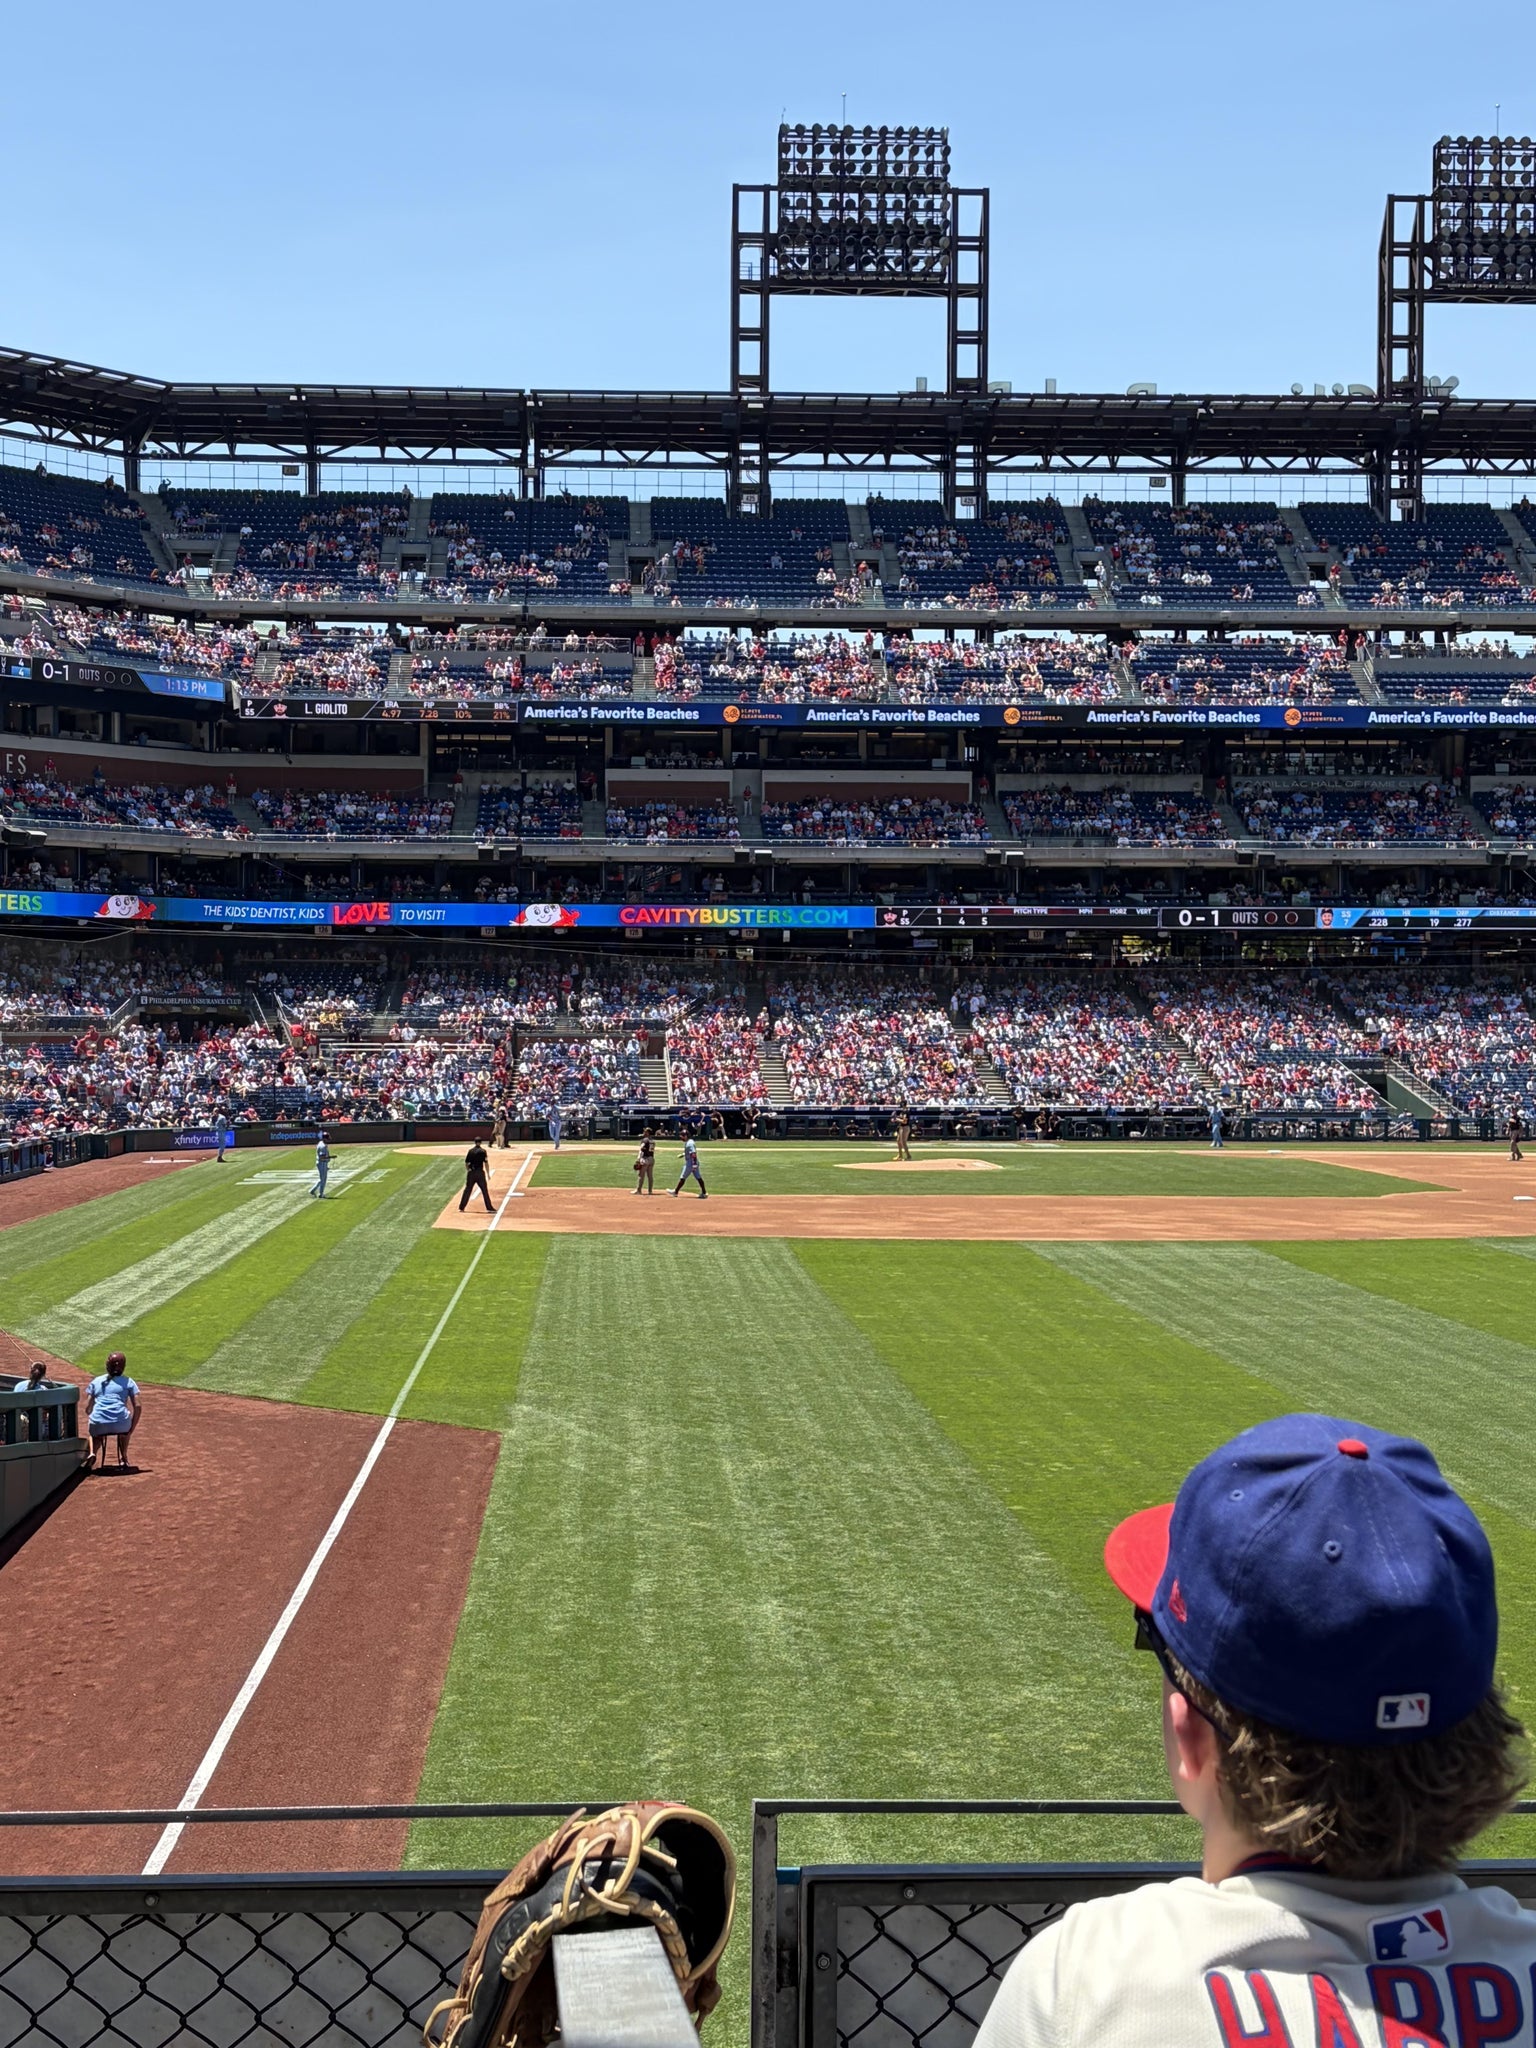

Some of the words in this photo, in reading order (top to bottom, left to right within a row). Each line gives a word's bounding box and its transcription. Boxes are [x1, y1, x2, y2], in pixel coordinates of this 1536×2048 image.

[79, 668, 100, 682] OUTS
[166, 678, 189, 692] 1:13
[191, 681, 207, 694] PM
[315, 703, 348, 716] GIOLITO
[384, 701, 399, 709] ERA
[423, 701, 435, 709] FIP
[381, 708, 401, 719] 4.97
[419, 709, 439, 719] 7.28
[454, 710, 472, 720] 10%
[493, 710, 510, 720] 21%
[524, 706, 588, 719] America's
[590, 706, 645, 720] Favorite
[646, 707, 699, 720] Beaches
[806, 708, 869, 722] America's
[872, 709, 925, 722] Favorite
[928, 710, 980, 722] Beaches
[1087, 710, 1150, 722] America's
[1152, 710, 1206, 723] Favorite
[1208, 711, 1261, 723] Beaches
[1368, 711, 1431, 724] America's
[1433, 711, 1487, 724] Favorite
[1489, 711, 1536, 724] Beache
[1311, 780, 1344, 788] HALL
[1345, 780, 1362, 788] OF
[1364, 780, 1396, 788] FAME
[204, 905, 222, 916] THE
[299, 908, 325, 919] KIDS
[333, 902, 391, 925] LOVE
[400, 909, 415, 921] TO
[416, 910, 446, 921] VISIT!
[620, 907, 849, 924] CAVITYBUSTERS.COM
[1232, 911, 1259, 924] OUTS
[958, 916, 966, 925] 4
[1368, 918, 1388, 927] .228
[1403, 918, 1410, 927] 7
[1430, 918, 1440, 927] 19
[1453, 918, 1473, 927] .277
[174, 1134, 202, 1146] xfinity
[270, 1132, 316, 1141] Independence
